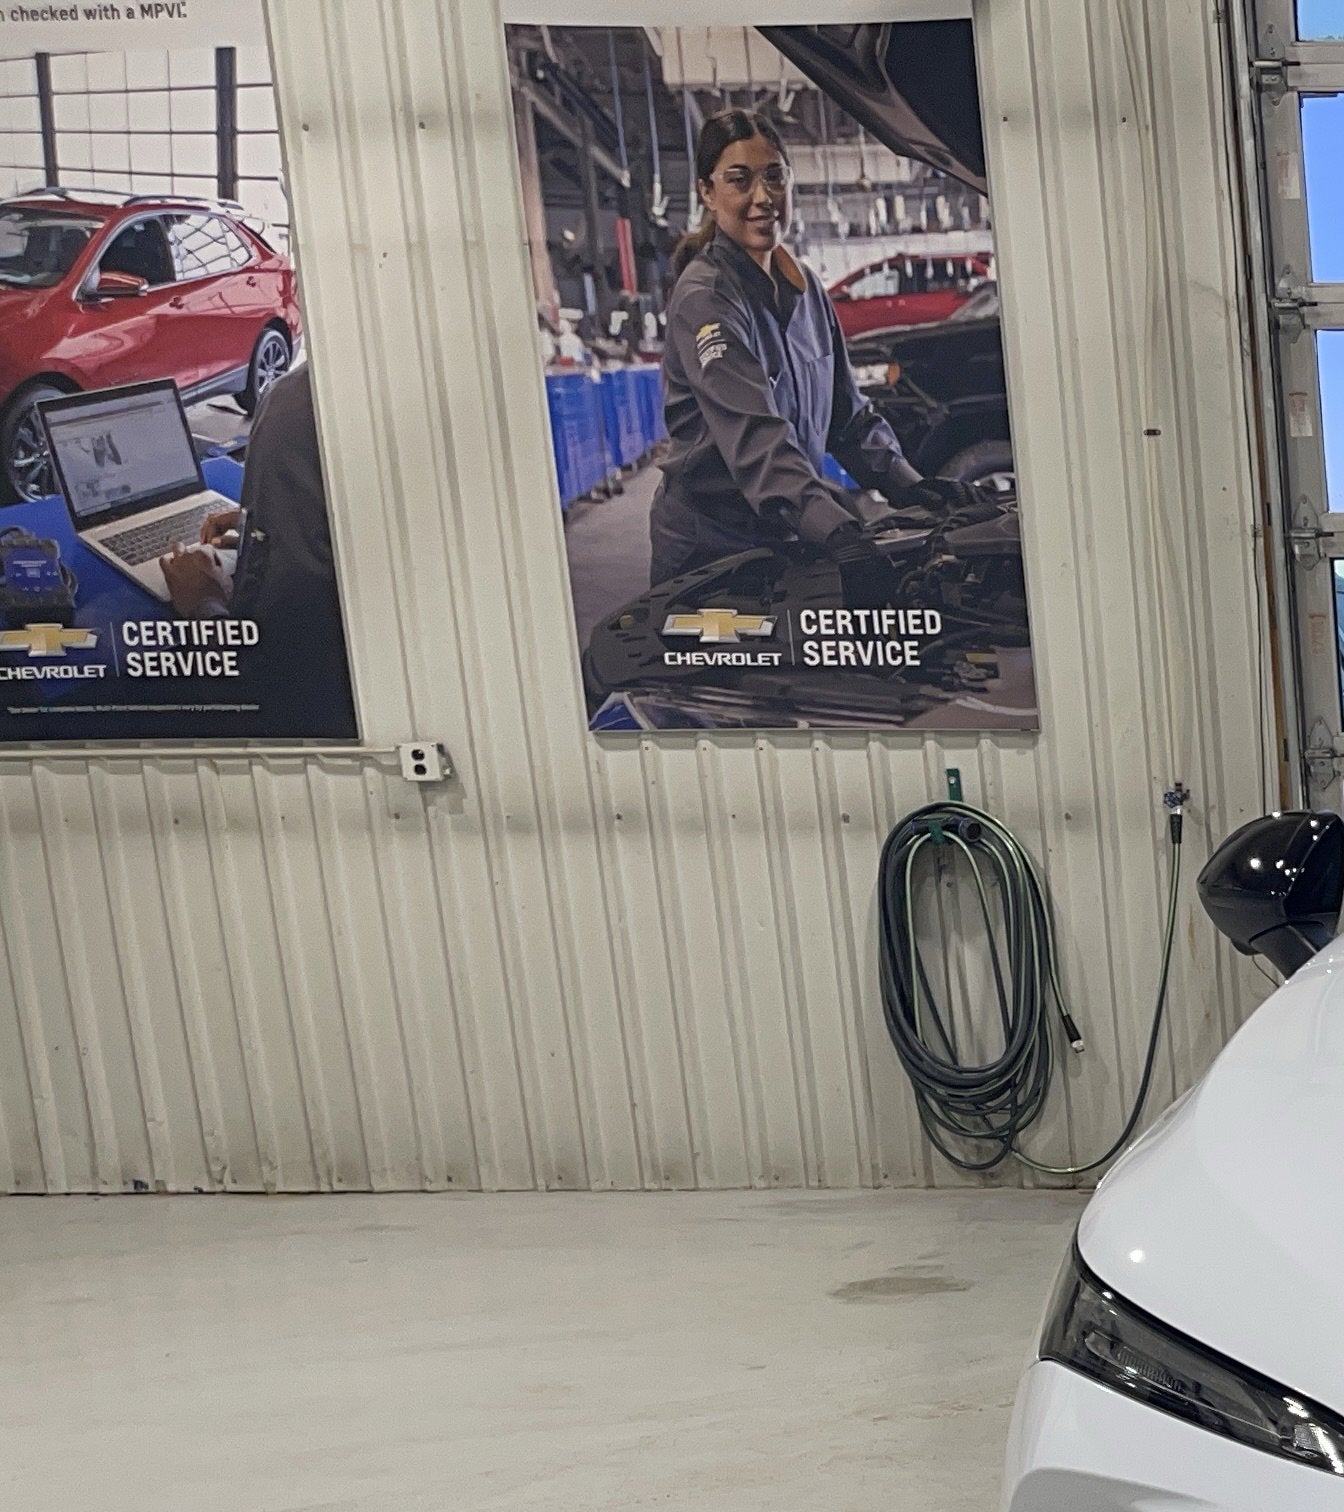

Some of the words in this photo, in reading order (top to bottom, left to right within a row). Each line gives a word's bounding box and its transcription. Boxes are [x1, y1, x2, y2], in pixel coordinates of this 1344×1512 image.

[10, 5, 79, 22] checked
[83, 4, 121, 21] with
[126, 7, 135, 20] a
[122, 620, 260, 647] CERTIFIED
[800, 608, 942, 636] CERTIFIED
[126, 651, 240, 677] SERVICE
[664, 652, 782, 666] CHEVROLET
[803, 640, 921, 667] SERVICE
[0, 664, 107, 680] CHEVROLET
